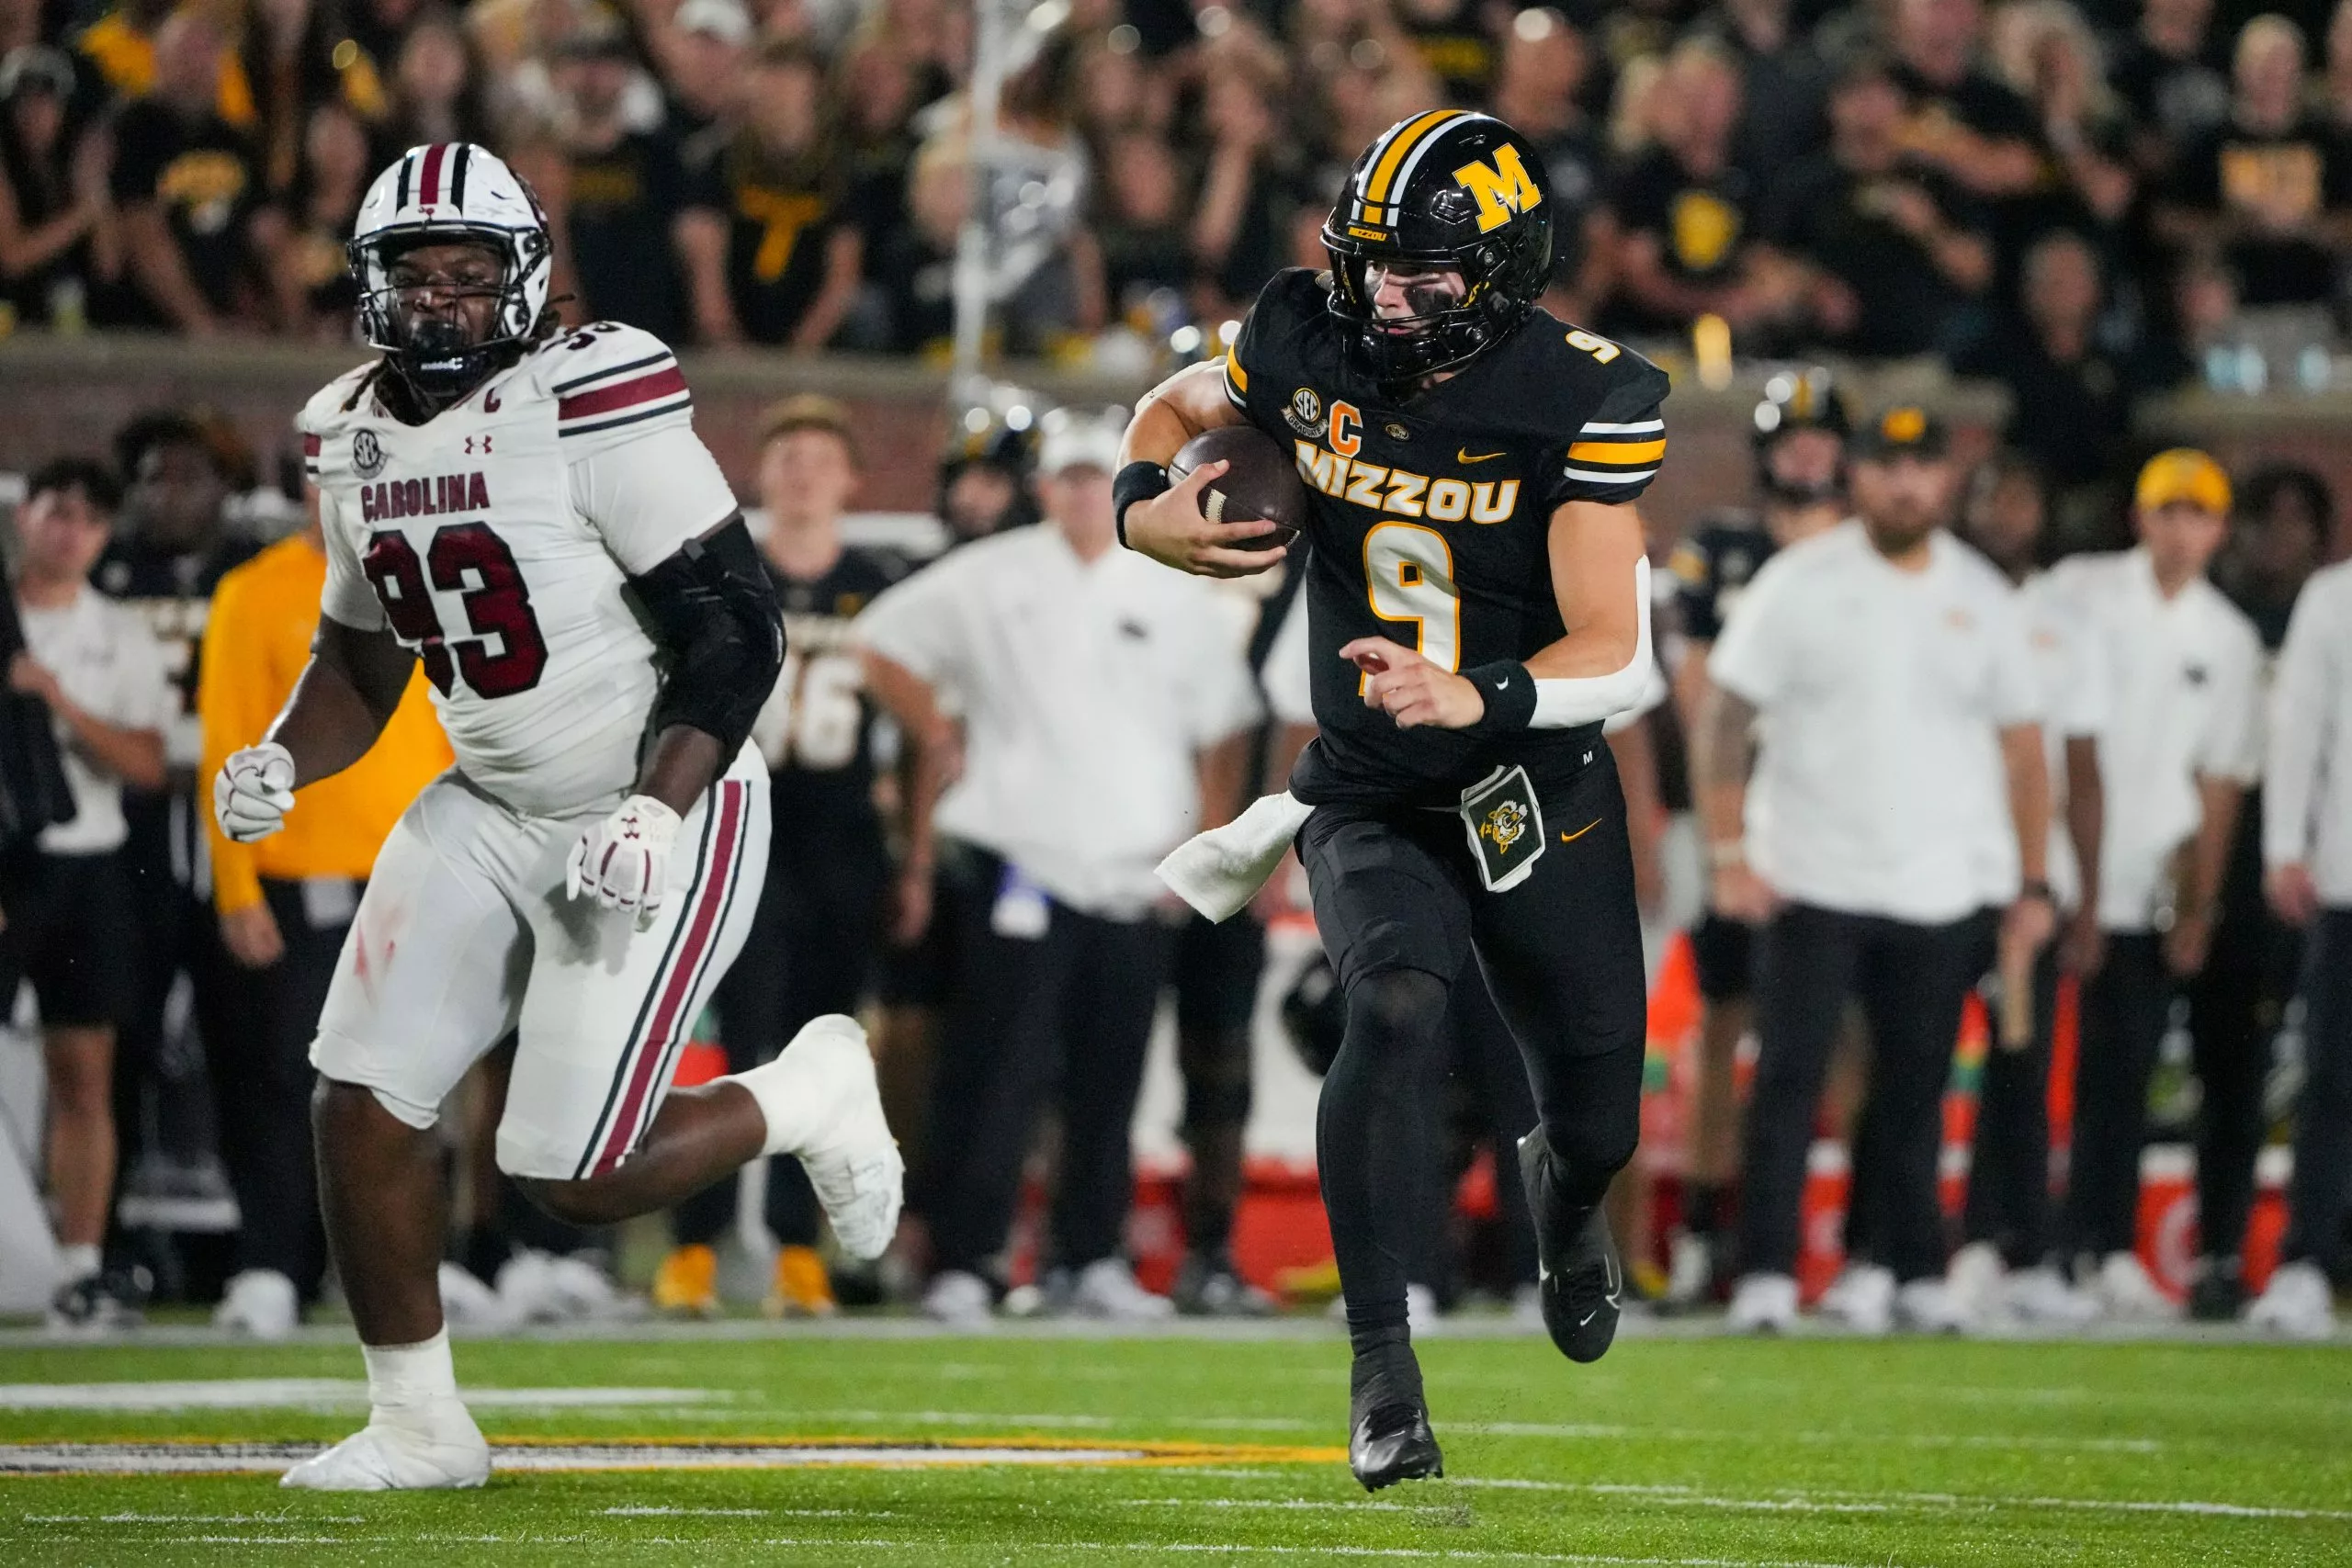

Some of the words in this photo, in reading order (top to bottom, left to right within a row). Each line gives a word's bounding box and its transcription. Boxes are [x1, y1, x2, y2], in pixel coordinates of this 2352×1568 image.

[1452, 141, 1543, 235] M
[1348, 227, 1387, 242] MIZZOU
[1565, 329, 1621, 365] 9
[1288, 414, 1323, 437] GRADUATE
[1295, 390, 1318, 421] SEC
[356, 433, 378, 466] SEC
[1328, 399, 1363, 458] C
[361, 471, 491, 524] CAROLINA
[1294, 438, 1521, 525] MIZZOU
[363, 521, 549, 700] 93
[1358, 520, 1461, 697] 9
[1582, 750, 1593, 765] M
